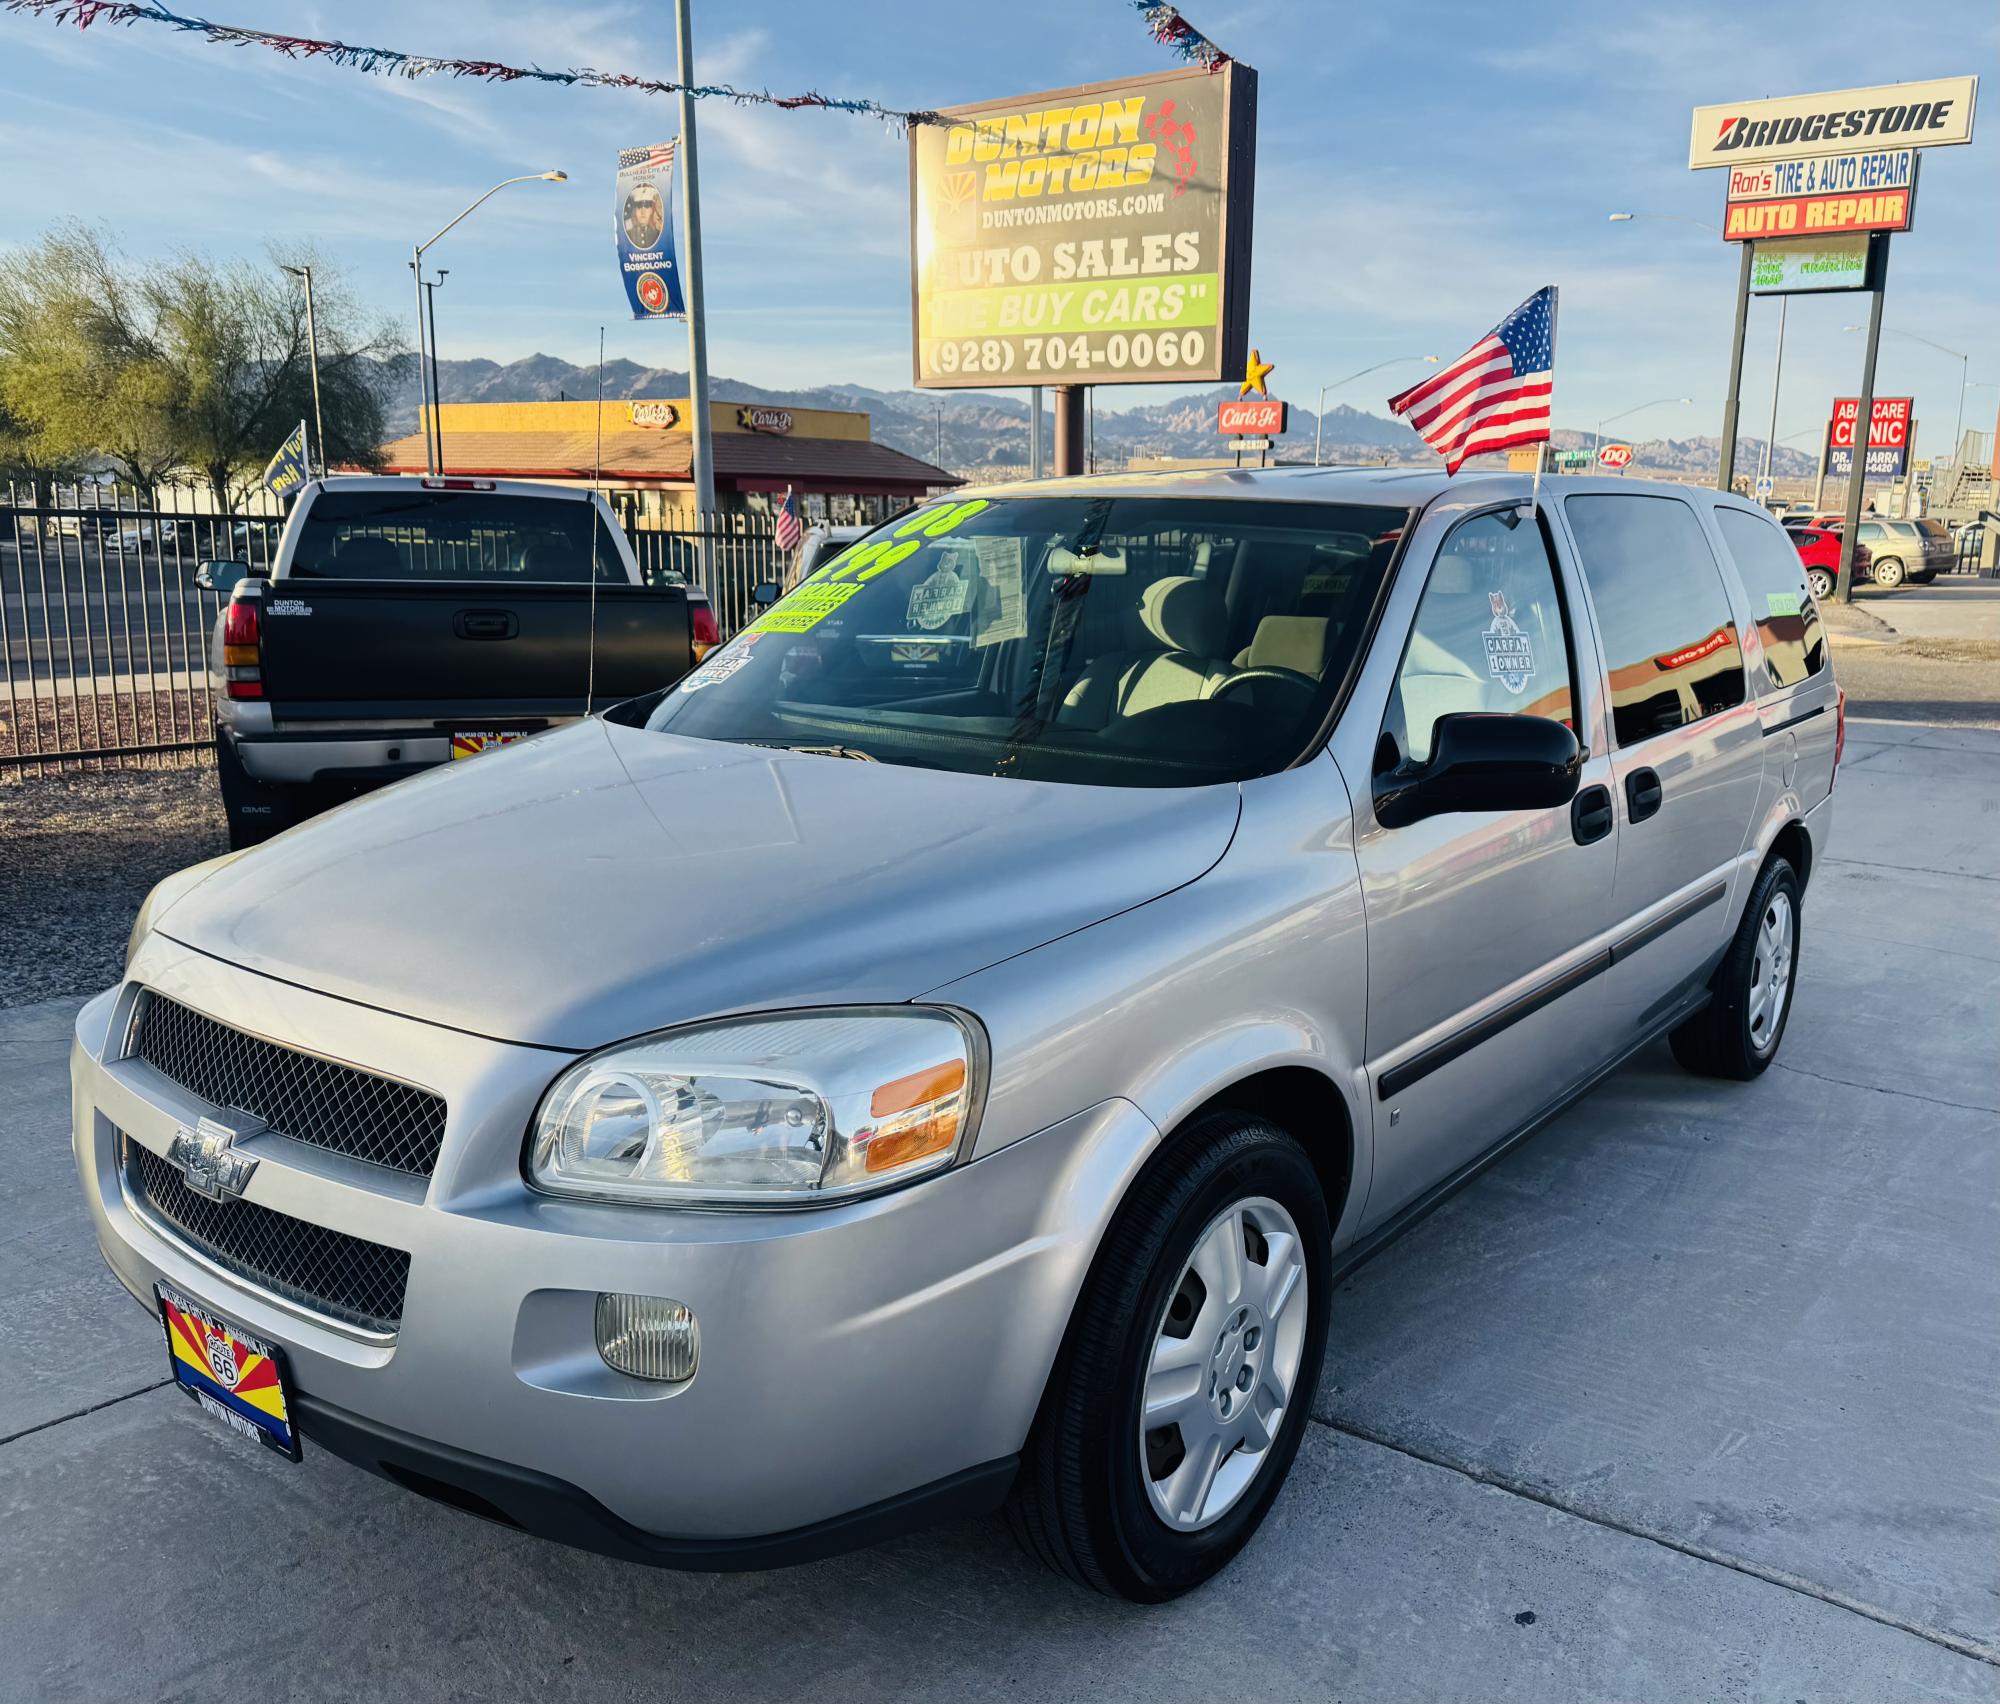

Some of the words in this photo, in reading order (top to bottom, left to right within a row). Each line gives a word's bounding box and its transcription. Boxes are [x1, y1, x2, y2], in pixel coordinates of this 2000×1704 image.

[945, 96, 1146, 165] DUNTON
[1713, 99, 1954, 151] BRIDGESTONE
[982, 143, 1157, 202] MOTORS
[1731, 170, 1773, 195] Ron's
[1774, 159, 1803, 194] TIRE
[1806, 168, 1816, 192] &
[1819, 156, 1856, 191] AUTO
[1859, 151, 1910, 187] REPAIR
[982, 194, 1164, 229] DUNTONMOTORS.COM
[1727, 203, 1798, 234] AUTO
[1805, 195, 1903, 228] REPAIR
[629, 252, 663, 263] VINCENT
[934, 245, 1041, 287] UTO
[1053, 232, 1200, 280] SALES
[998, 289, 1075, 328] BUY
[1082, 283, 1207, 322] CARS"
[929, 339, 1014, 374] (928)
[1024, 330, 1205, 370] 704-0060
[1221, 407, 1258, 428] Carl's
[1258, 406, 1278, 428] Jr.
[1873, 402, 1905, 418] CARE
[1835, 421, 1903, 443] CLNIC
[1604, 449, 1628, 463] DQ
[1832, 451, 1850, 464] DR.
[893, 499, 989, 538] 08
[1486, 638, 1530, 653] CARFAX
[1498, 655, 1533, 671] OWNER
[242, 806, 272, 814] GMC
[209, 1339, 232, 1358] ROUTE
[213, 1353, 234, 1380] 66
[197, 1391, 230, 1425] DUNTON
[226, 1410, 261, 1443] MOTORS
